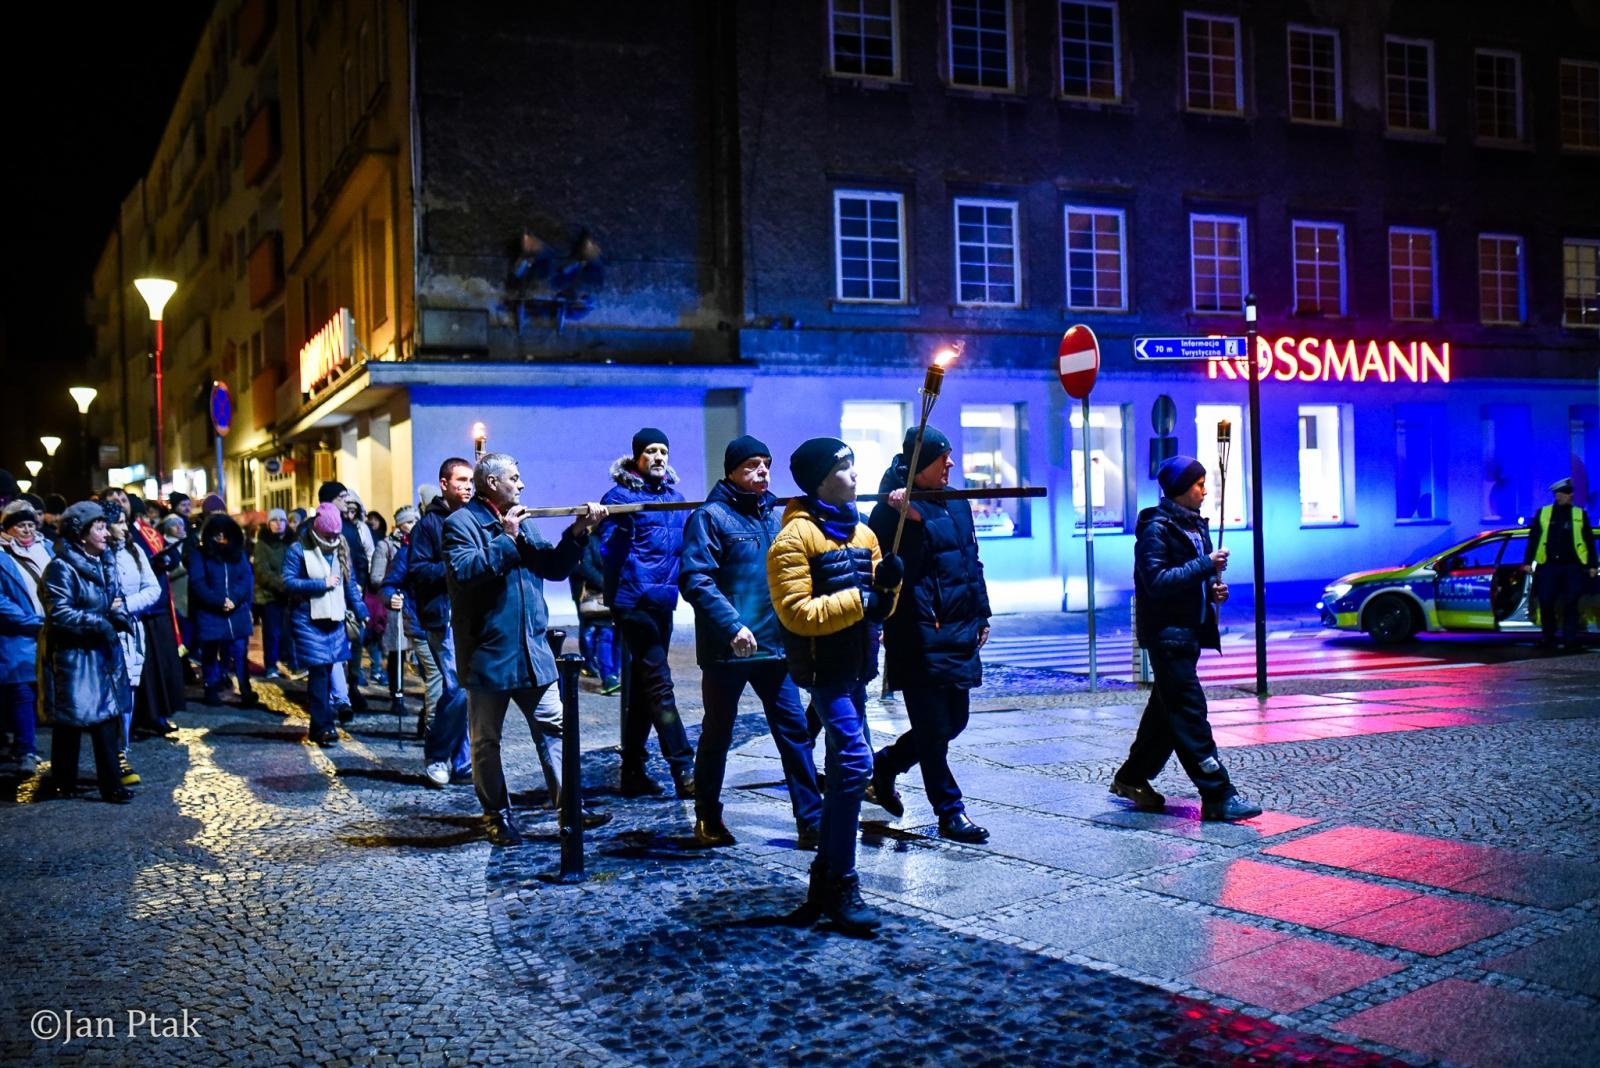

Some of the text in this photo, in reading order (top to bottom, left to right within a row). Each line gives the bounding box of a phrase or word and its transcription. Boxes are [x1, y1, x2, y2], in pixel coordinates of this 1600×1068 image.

[1181, 340, 1219, 348] Informacja
[1155, 345, 1164, 353] 70
[1181, 348, 1222, 357] Turystyczna
